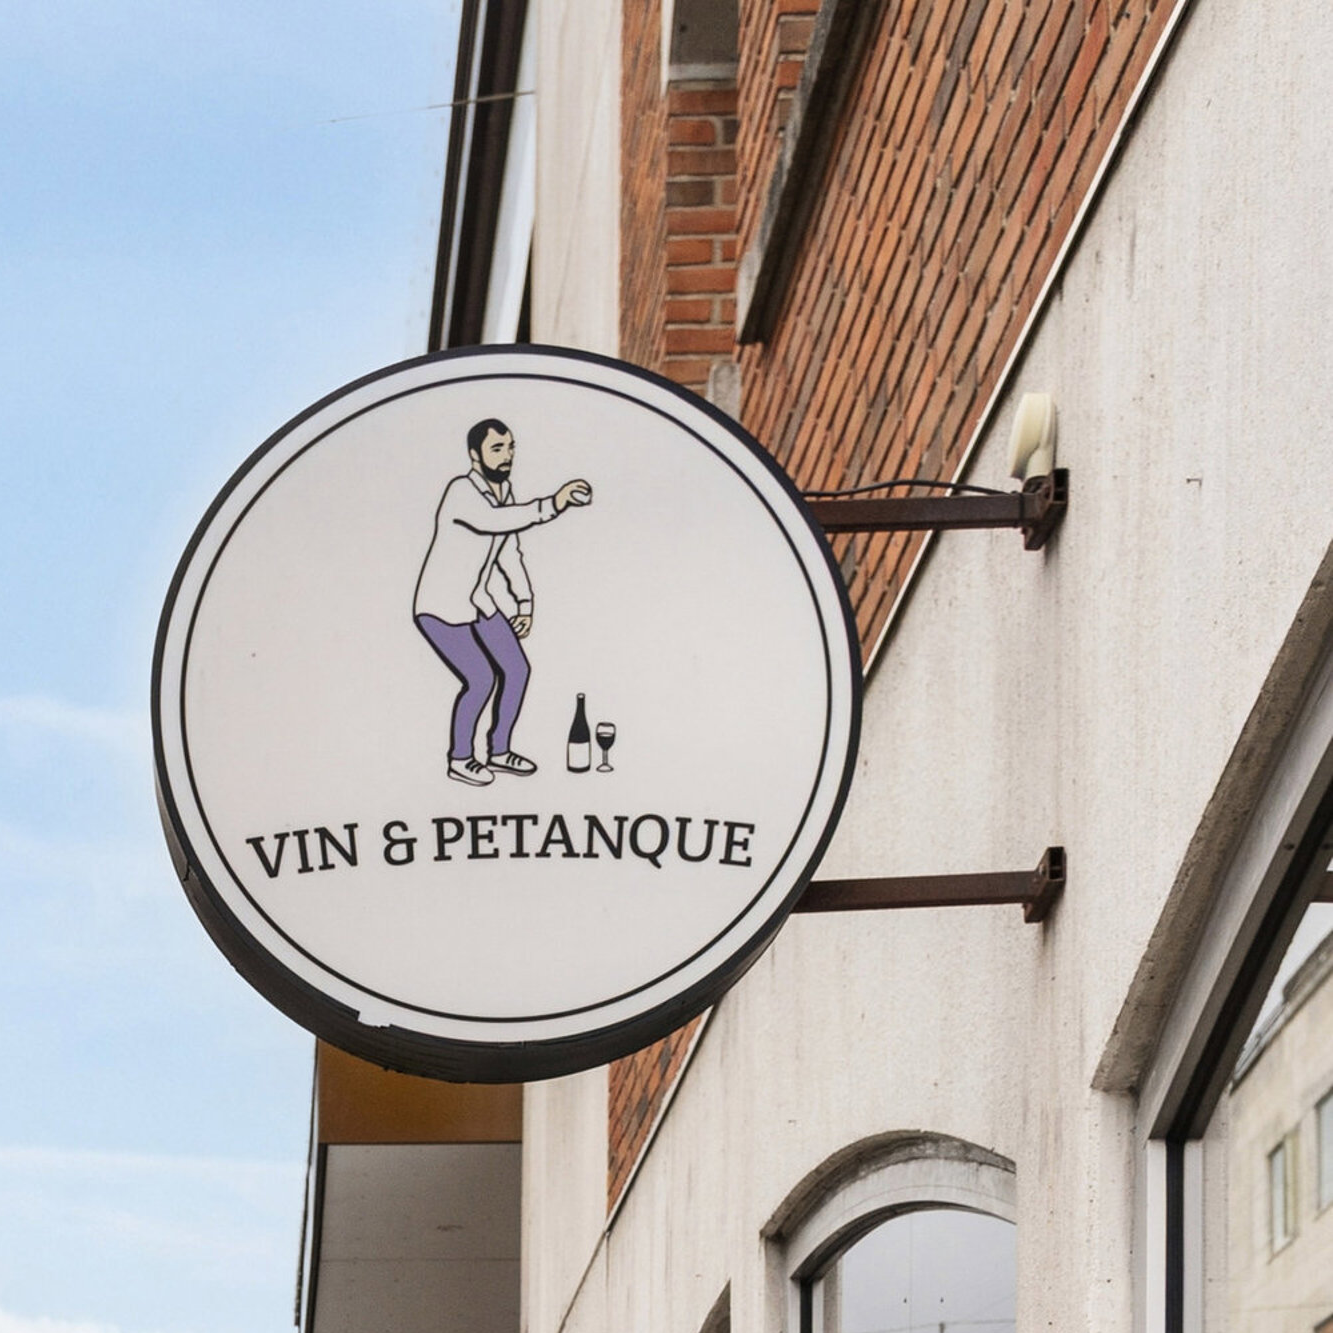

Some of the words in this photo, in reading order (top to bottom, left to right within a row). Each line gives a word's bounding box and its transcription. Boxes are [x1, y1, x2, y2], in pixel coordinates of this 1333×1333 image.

[245, 822, 359, 879] VIN
[382, 820, 418, 866] &
[431, 813, 755, 869] PETANQUE
